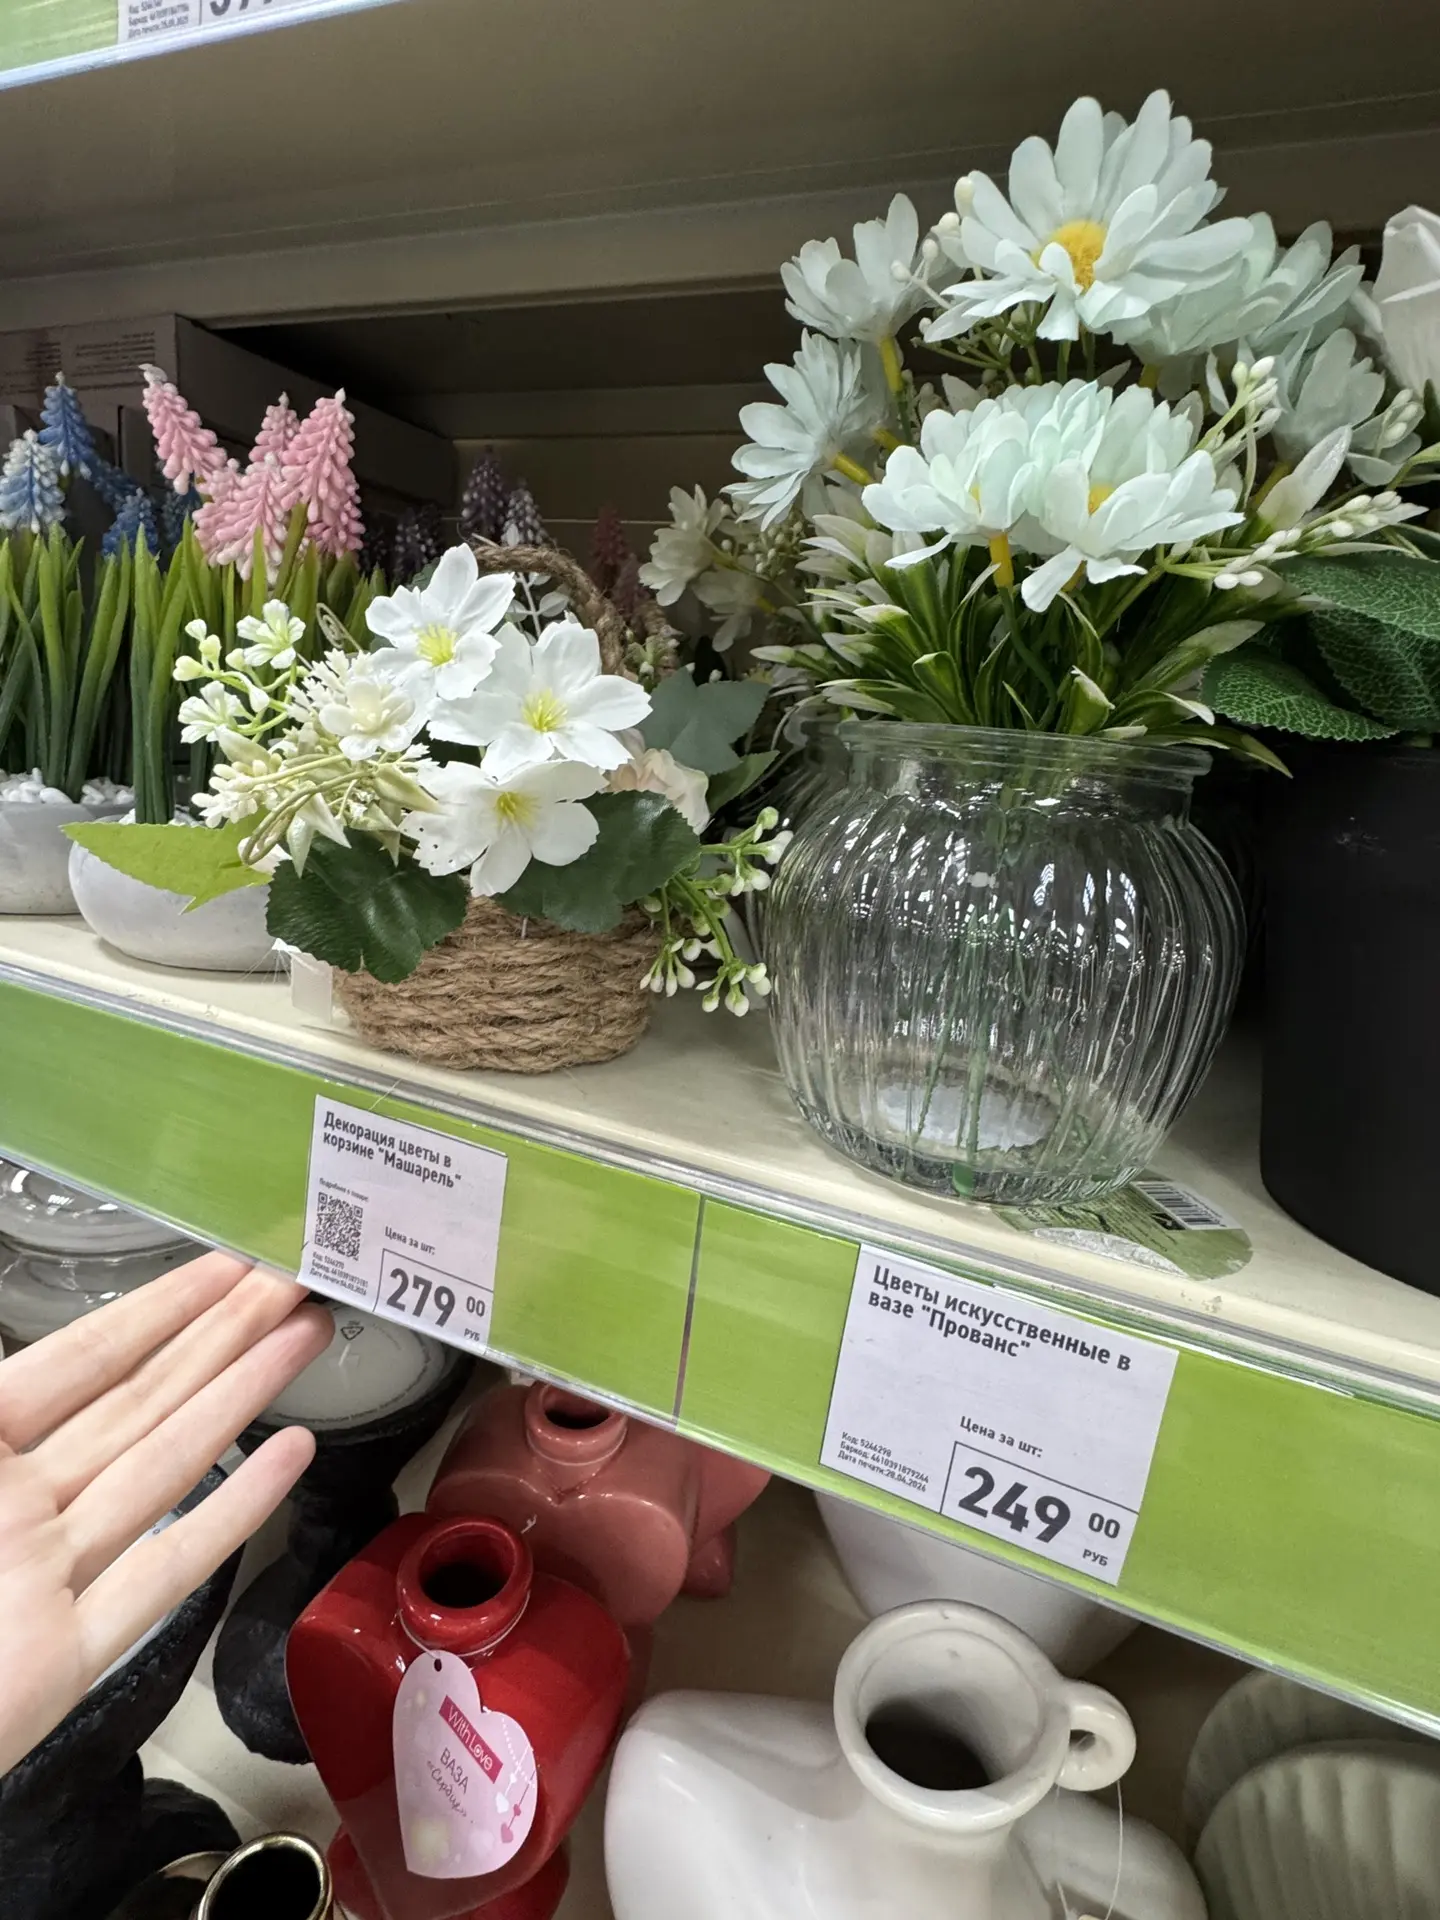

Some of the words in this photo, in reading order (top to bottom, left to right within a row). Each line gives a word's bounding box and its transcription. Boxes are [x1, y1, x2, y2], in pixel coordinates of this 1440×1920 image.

[323, 1131, 375, 1160] корзине
[378, 1147, 461, 1188] "Машарель"
[324, 1110, 396, 1149] Декорация
[399, 1139, 440, 1165] цветы
[443, 1155, 452, 1168] в
[385, 1226, 407, 1244] Цена
[409, 1237, 419, 1249] за
[386, 1267, 456, 1327] 279
[466, 1296, 486, 1317] 00
[872, 1264, 940, 1305] Цветы
[944, 1293, 1111, 1365] искусственные
[1116, 1353, 1132, 1372] в
[464, 1327, 481, 1342] РУБ
[868, 1290, 915, 1319] вазе
[921, 1304, 1031, 1358] "Прованс"
[837, 1450, 857, 1465] Дата
[840, 1440, 870, 1460] Баркод:
[841, 1431, 860, 1446] Код:
[959, 1415, 996, 1440] Цена
[998, 1432, 1015, 1447] за
[1018, 1440, 1044, 1458] шт:
[957, 1466, 1072, 1544] 249
[1087, 1511, 1121, 1540] 00
[1081, 1548, 1109, 1567] РУБ
[447, 1704, 471, 1744] With
[468, 1733, 493, 1771] Love
[440, 1747, 469, 1795] ВАЗА
